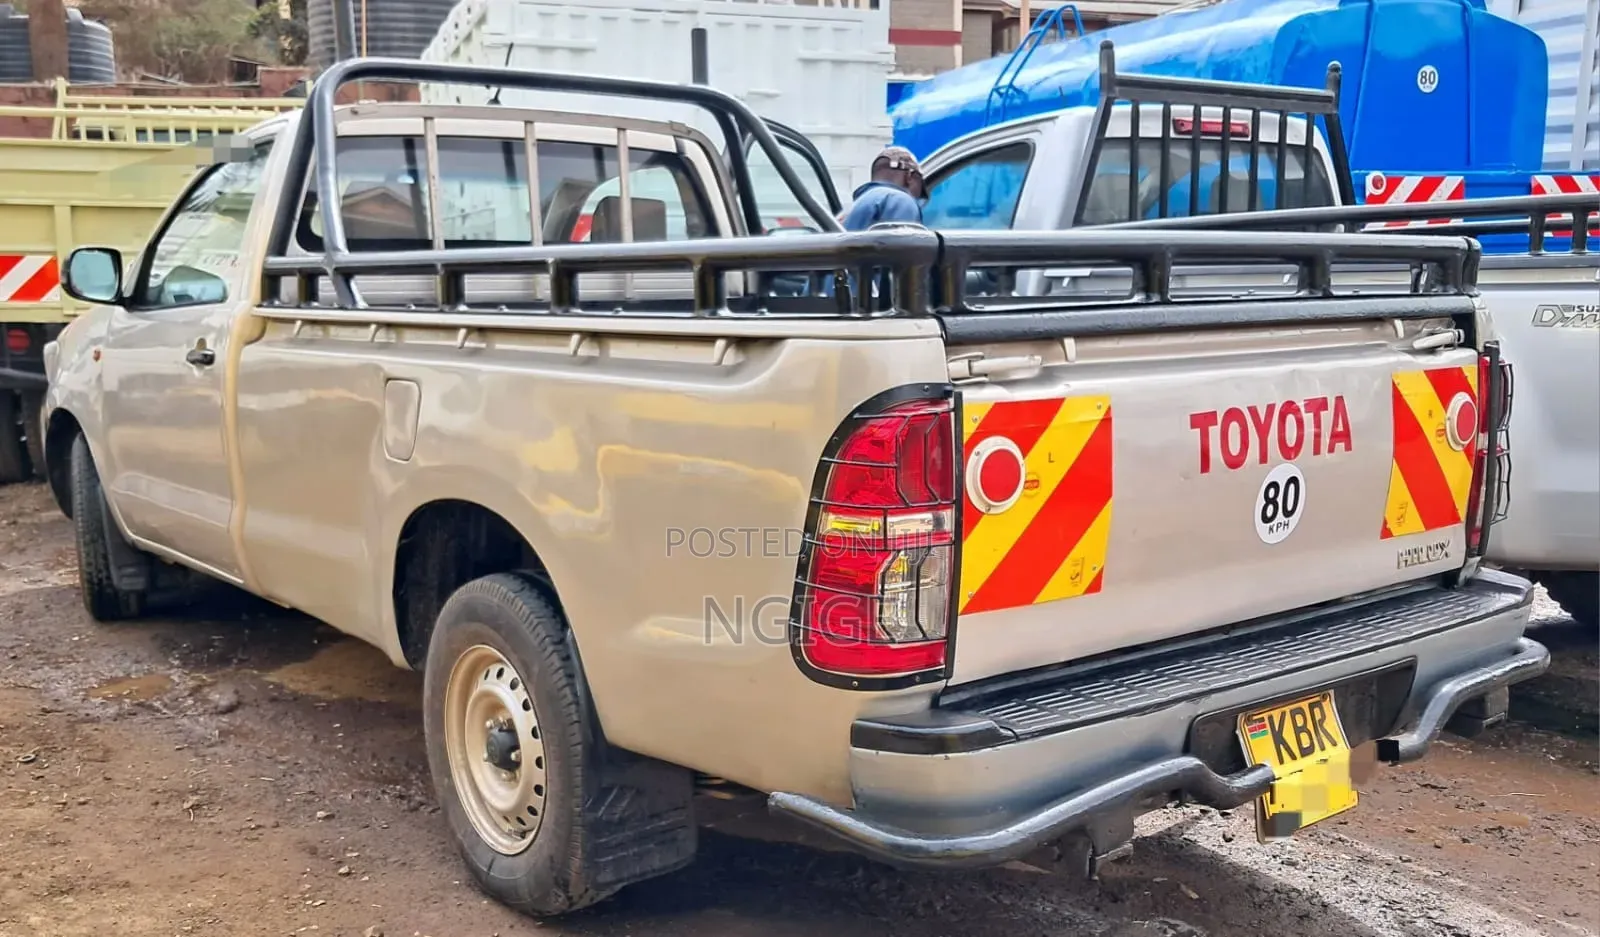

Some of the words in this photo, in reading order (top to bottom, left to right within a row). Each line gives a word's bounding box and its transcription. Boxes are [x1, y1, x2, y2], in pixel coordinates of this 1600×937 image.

[1420, 70, 1436, 85] 80
[1189, 395, 1352, 474] TOYOTA
[1261, 475, 1300, 524] 80
[1268, 520, 1290, 534] KPH
[1397, 539, 1450, 569] HILUX
[1268, 701, 1337, 765] KBR
